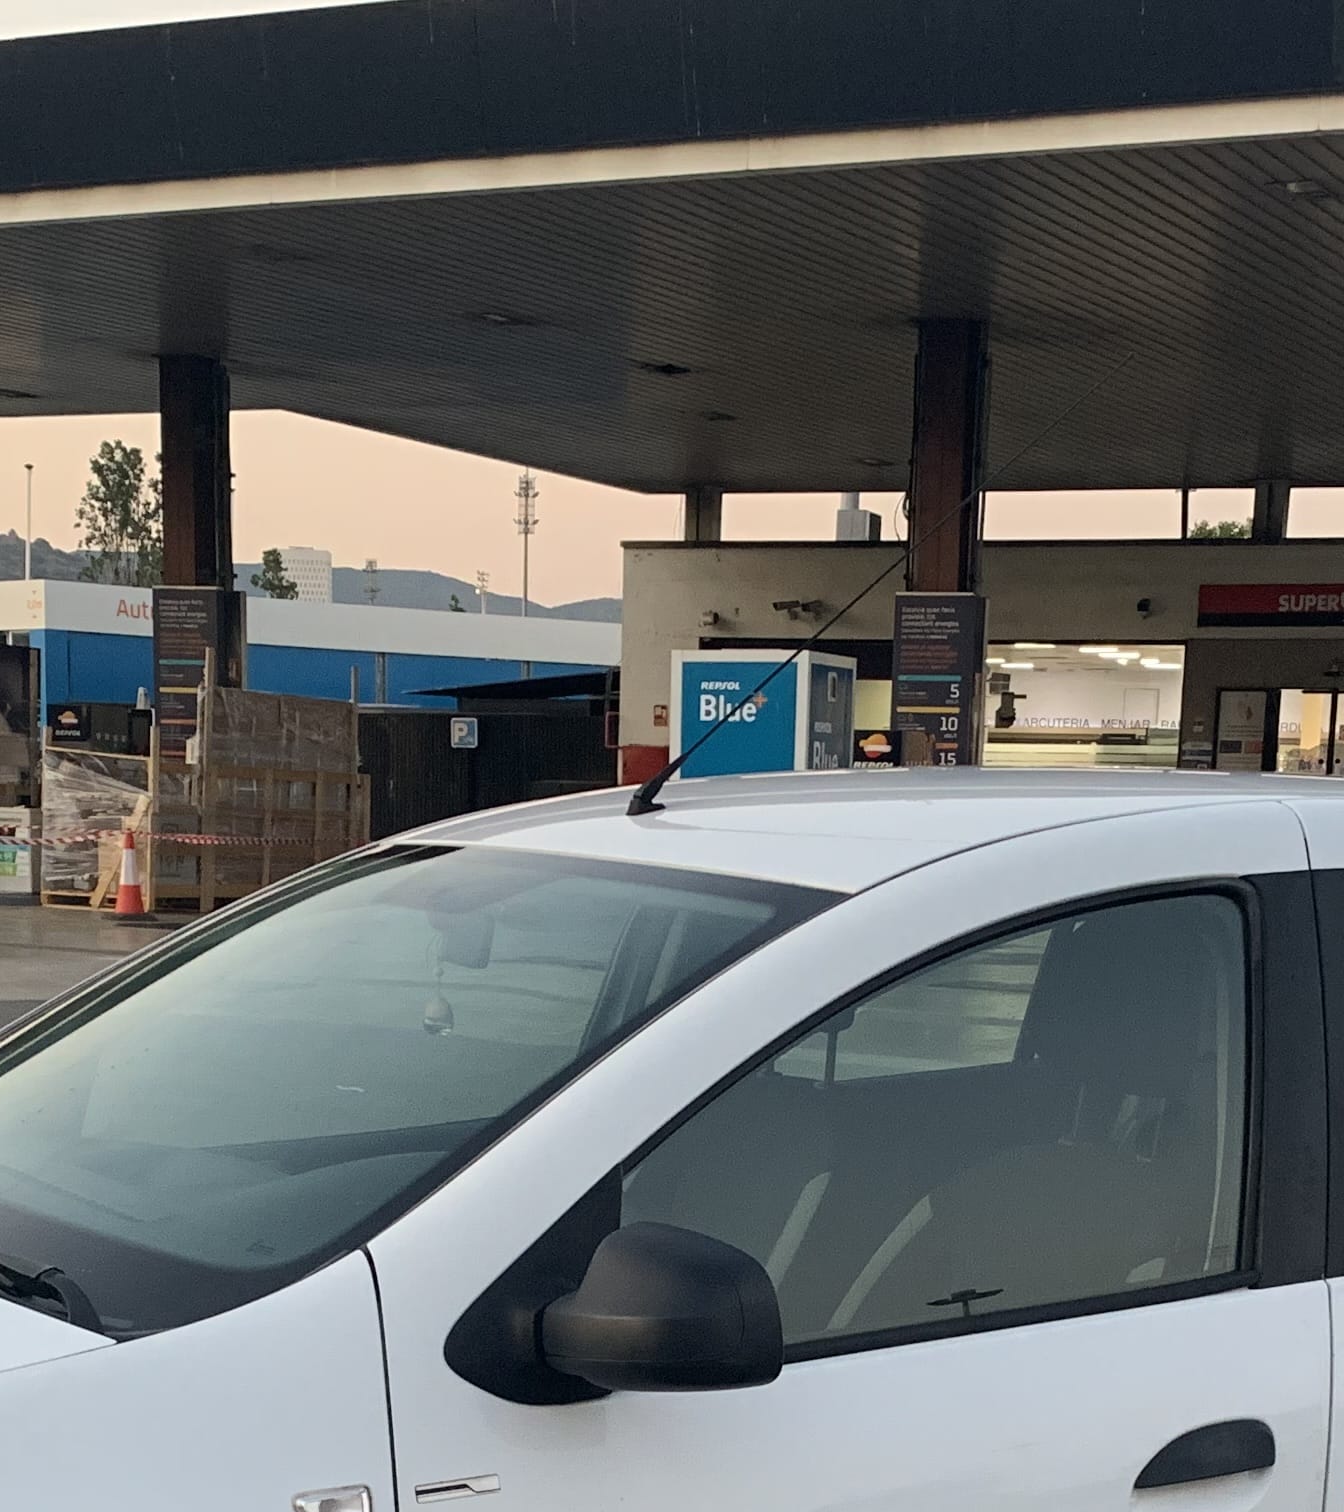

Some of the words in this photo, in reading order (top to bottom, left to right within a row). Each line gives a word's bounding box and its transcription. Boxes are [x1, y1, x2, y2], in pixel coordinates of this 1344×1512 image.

[700, 681, 741, 690] REPSOL
[949, 683, 960, 698] 5
[939, 716, 958, 731] 10
[938, 752, 956, 766] 15
